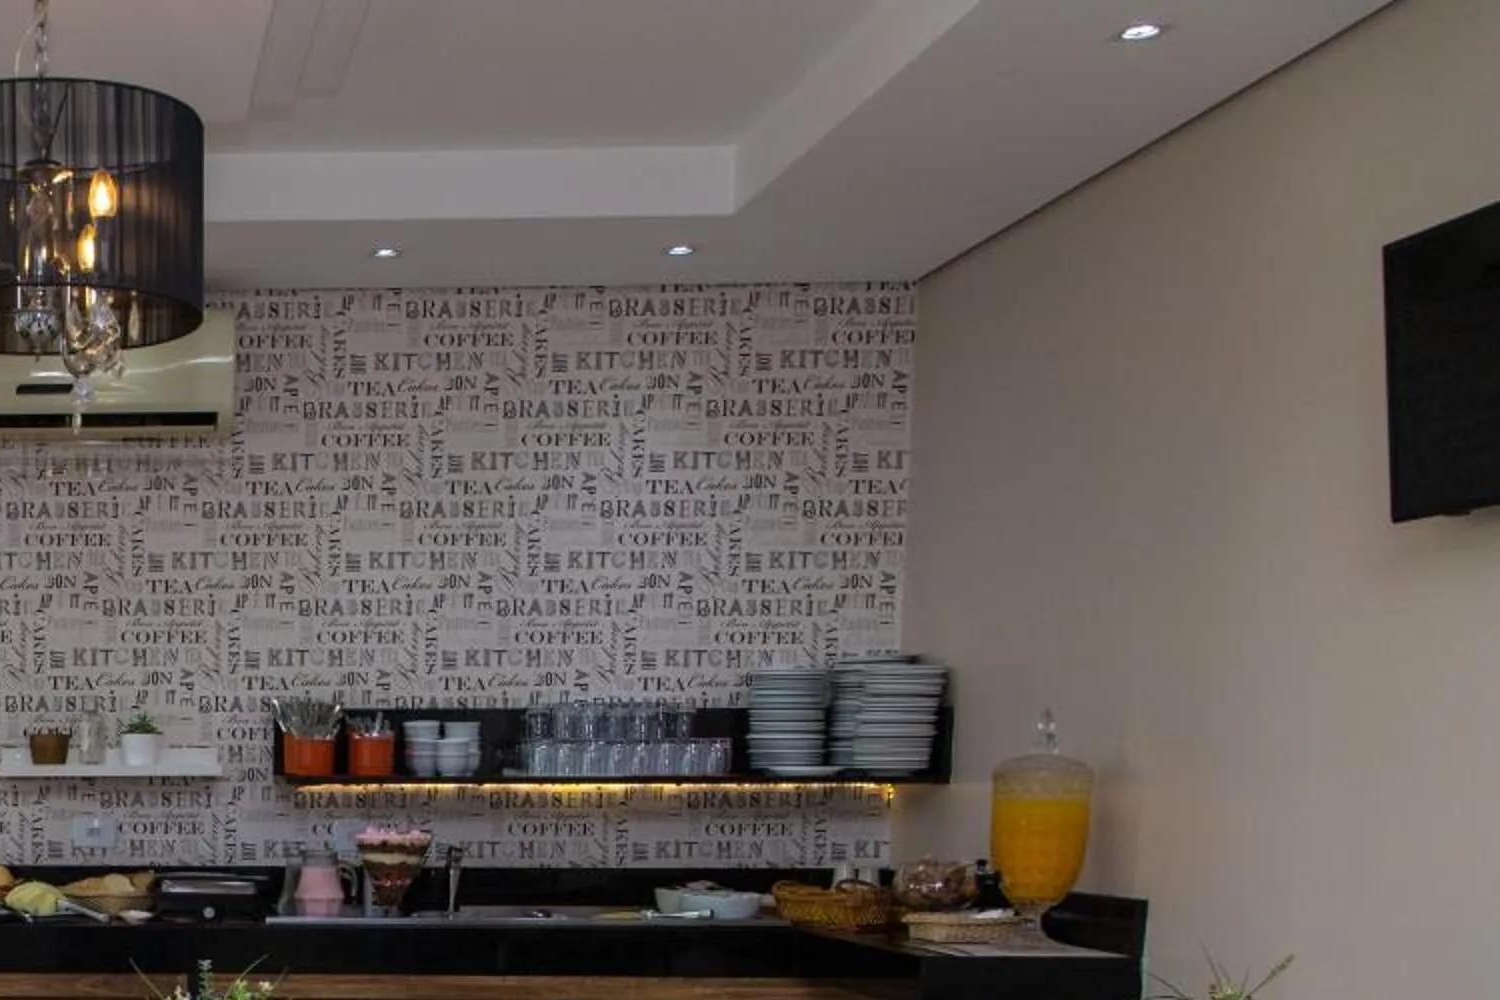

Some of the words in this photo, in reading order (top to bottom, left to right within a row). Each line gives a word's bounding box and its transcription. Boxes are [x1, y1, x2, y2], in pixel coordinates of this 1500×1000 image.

[424, 332, 514, 347] COFFEE
[626, 331, 718, 346] COFFEE
[373, 351, 484, 371] KITCHEN
[575, 350, 687, 370] KITCHEN
[779, 349, 893, 369] KITCHEN
[346, 380, 396, 396] TEA
[548, 379, 597, 395] TEA
[751, 378, 802, 394] TEA
[321, 433, 410, 448] COFFEE
[521, 432, 611, 447] COFFEE
[723, 432, 815, 446] COFFEE
[271, 452, 380, 471] KITCHEN
[471, 451, 581, 471] KITCHEN
[672, 450, 784, 470] KITCHEN
[48, 481, 96, 496] TEA
[245, 481, 293, 495] TEA
[444, 480, 493, 495] TEA
[645, 479, 694, 494] TEA
[848, 479, 899, 494] TEA
[24, 533, 111, 547] COFFEE
[220, 532, 308, 546] COFFEE
[418, 532, 507, 546] COFFEE
[618, 532, 708, 546] COFFEE
[171, 551, 279, 570] KITCHEN
[368, 550, 477, 570] KITCHEN
[567, 550, 678, 569] KITCHEN
[769, 550, 881, 569] KITCHEN
[145, 579, 193, 594] TEA
[341, 579, 390, 593] TEA
[540, 579, 589, 593] TEA
[741, 579, 791, 593] TEA
[120, 630, 207, 644] COFFEE
[316, 630, 404, 644] COFFEE
[514, 630, 603, 644] COFFEE
[714, 630, 804, 644] COFFEE
[72, 648, 179, 667] KITCHEN
[267, 648, 375, 667] KITCHEN
[464, 648, 574, 667] KITCHEN
[663, 648, 774, 667] KITCHEN
[47, 675, 94, 690] TEA
[241, 676, 289, 690] TEA
[438, 676, 486, 691] TEA
[636, 676, 685, 691] TEA
[118, 821, 204, 834] COFFEE
[507, 822, 596, 835] COFFEE
[705, 822, 794, 836] COFFEE
[655, 840, 764, 858] KITCHEN
